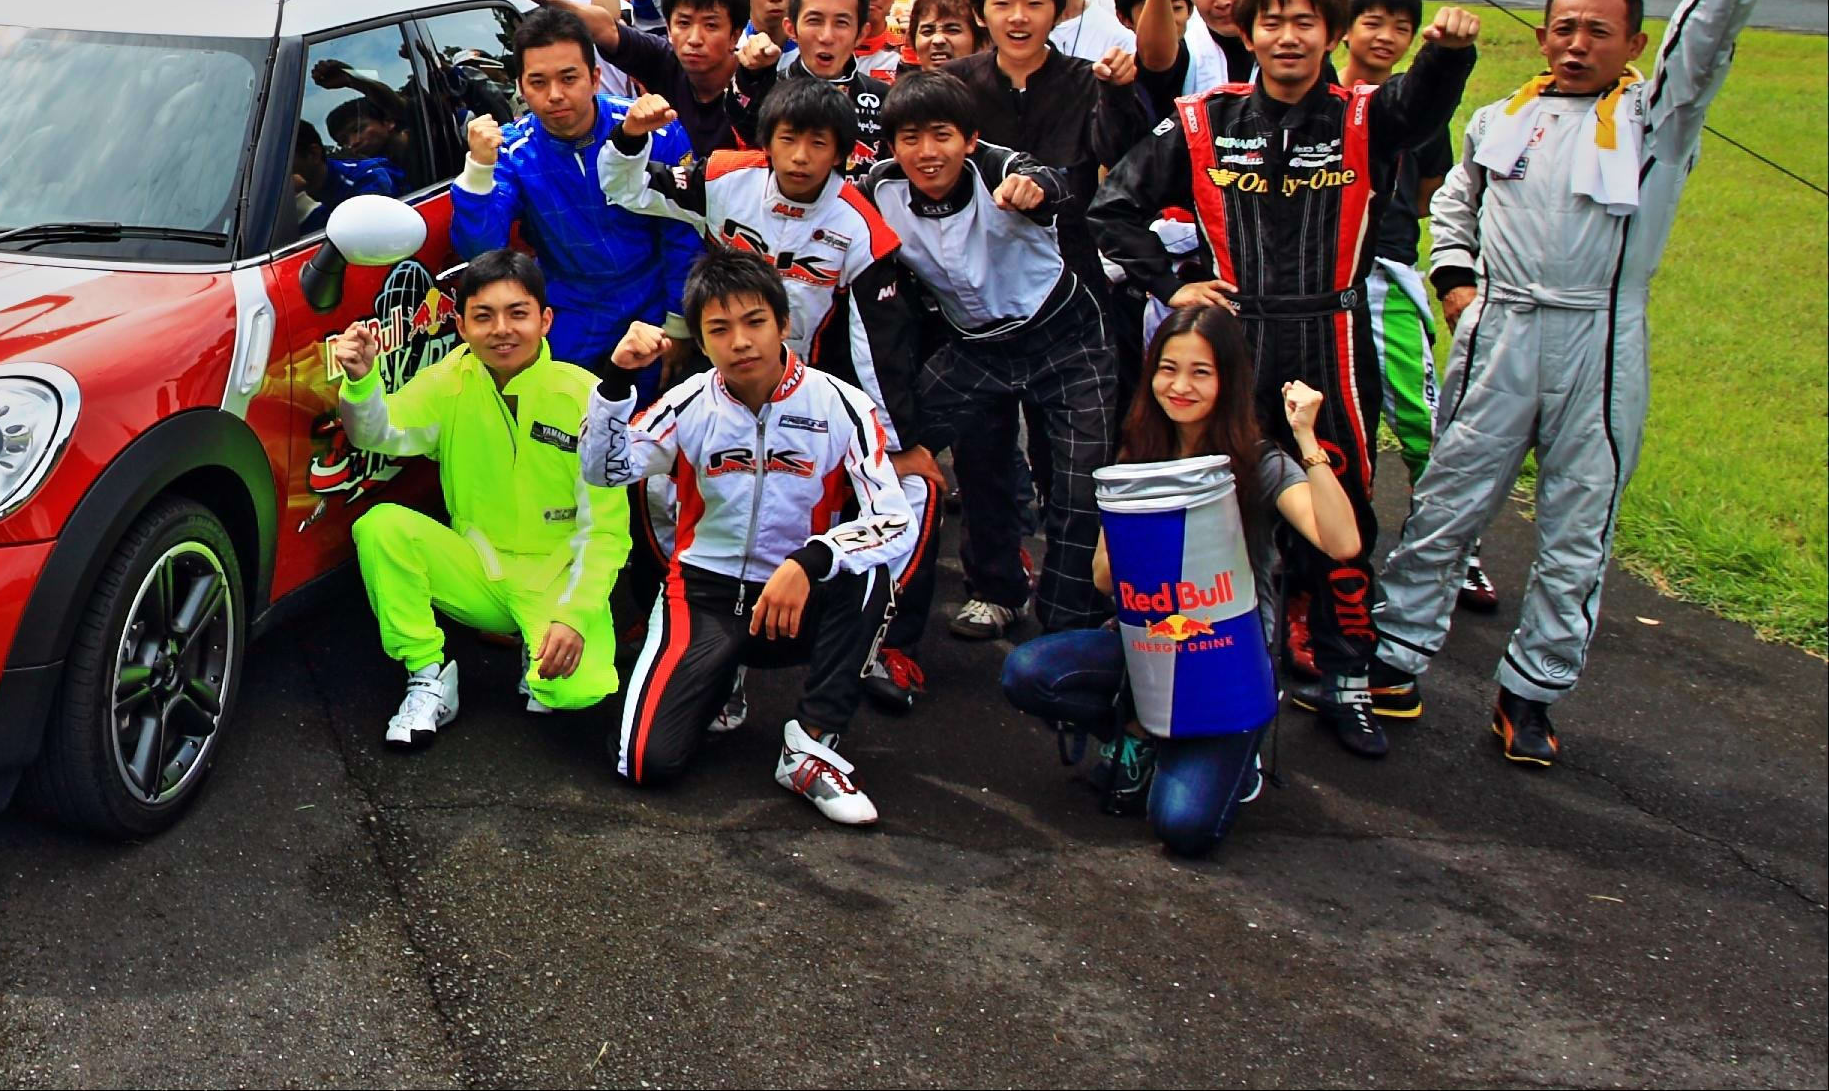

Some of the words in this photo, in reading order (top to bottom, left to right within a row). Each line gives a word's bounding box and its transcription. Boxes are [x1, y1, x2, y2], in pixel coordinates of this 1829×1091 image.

[542, 426, 571, 444] YAMAHA
[1119, 580, 1174, 612] Red
[1175, 570, 1236, 611] Bull
[1188, 635, 1235, 653] DRINK
